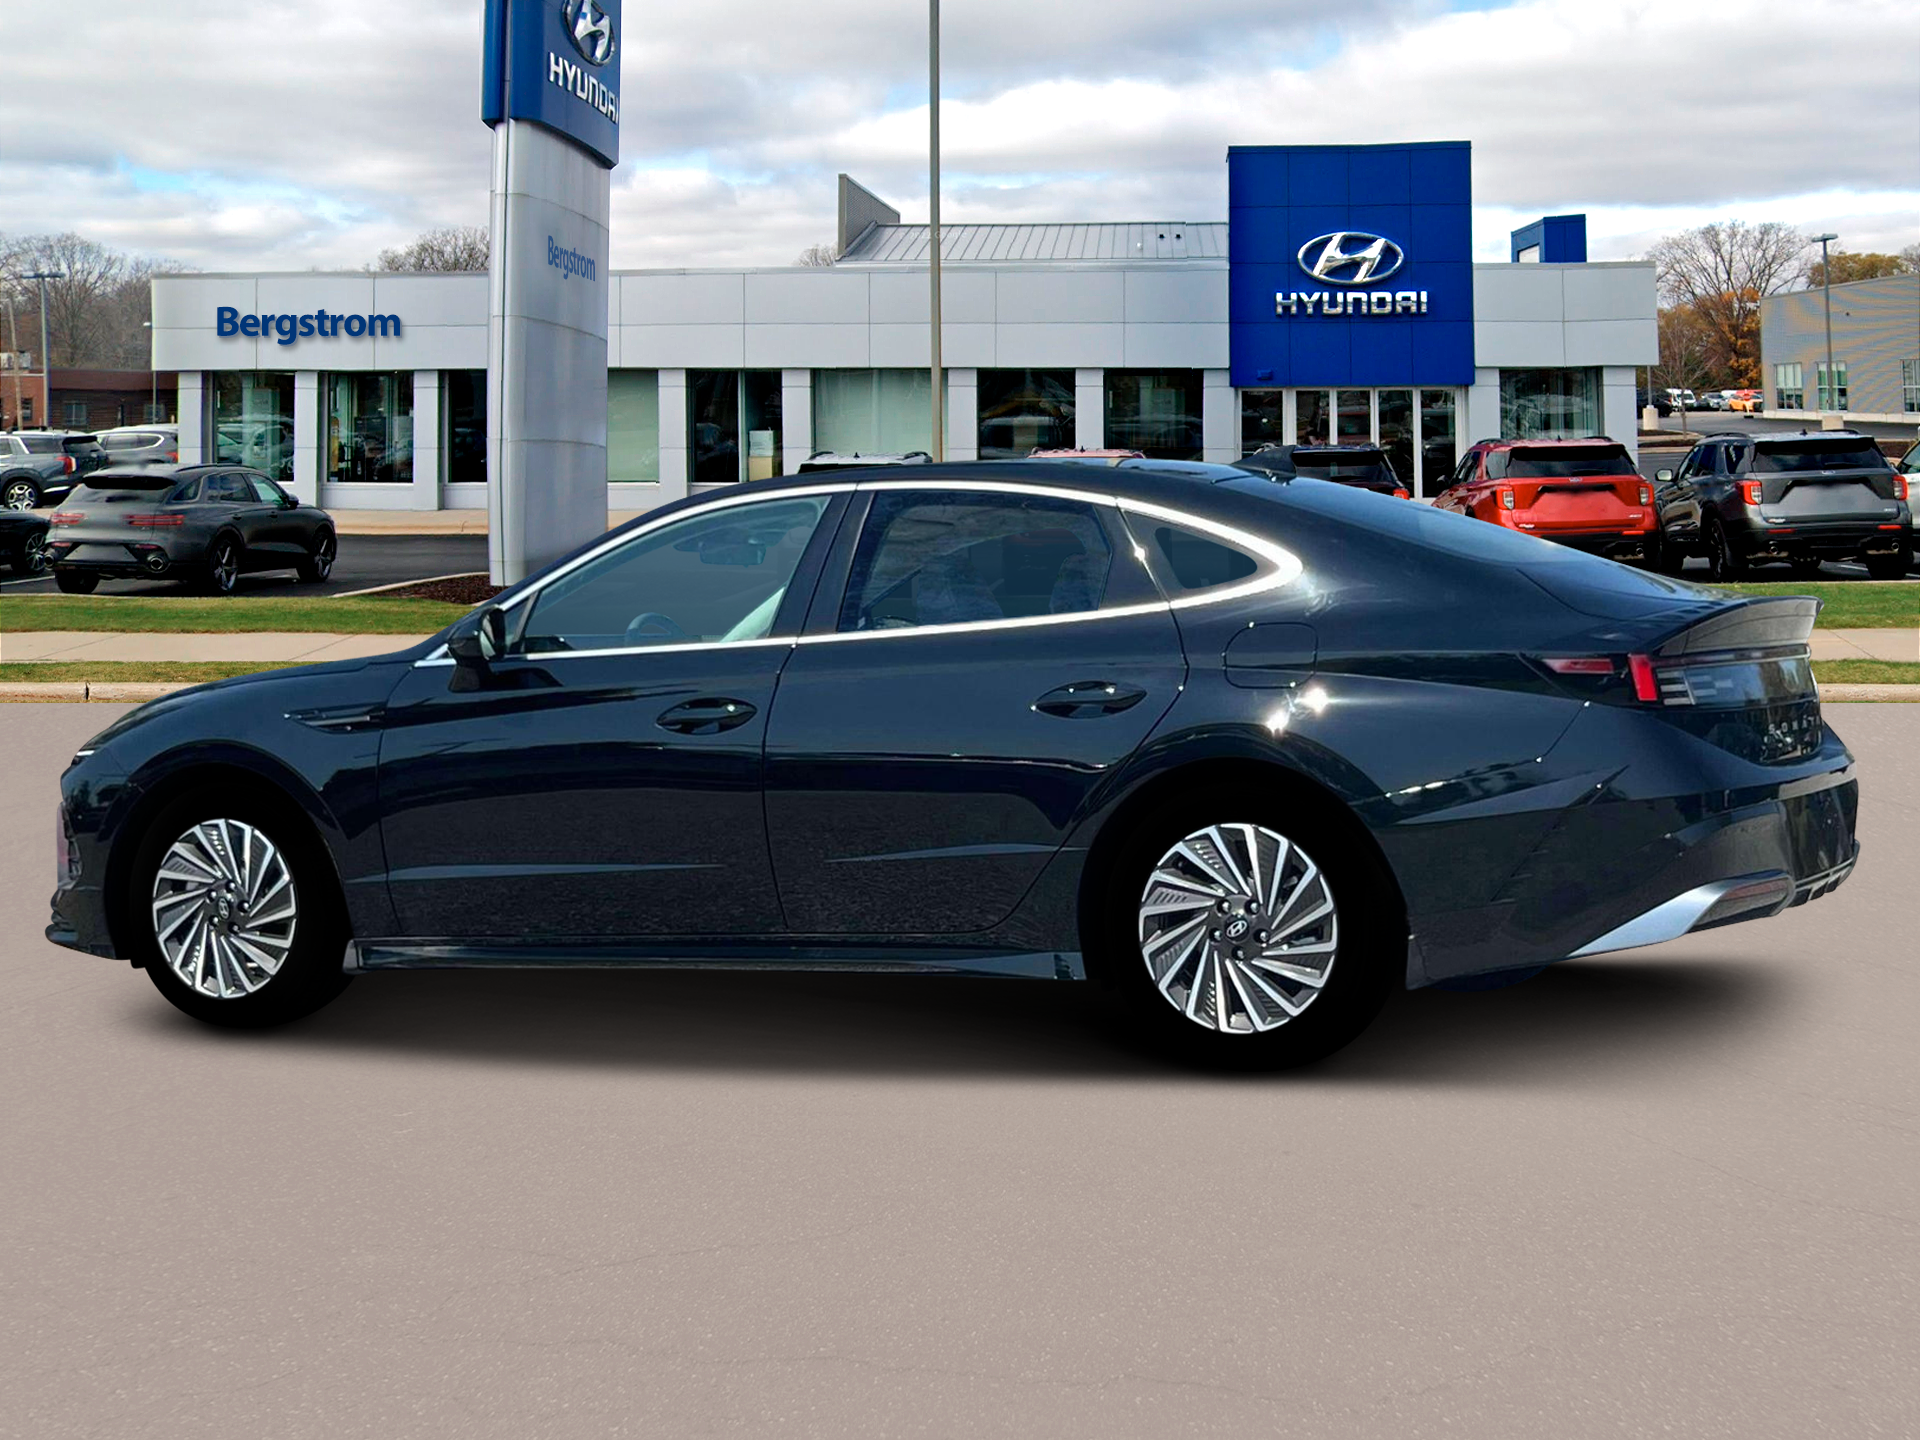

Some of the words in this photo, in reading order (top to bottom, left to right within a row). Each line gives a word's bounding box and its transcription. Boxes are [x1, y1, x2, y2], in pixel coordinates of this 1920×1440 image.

[549, 52, 619, 124] HYUNDAI
[547, 235, 596, 282] Bergstrom
[1275, 290, 1429, 316] HYUNDAI
[216, 306, 402, 346] Bergstrom
